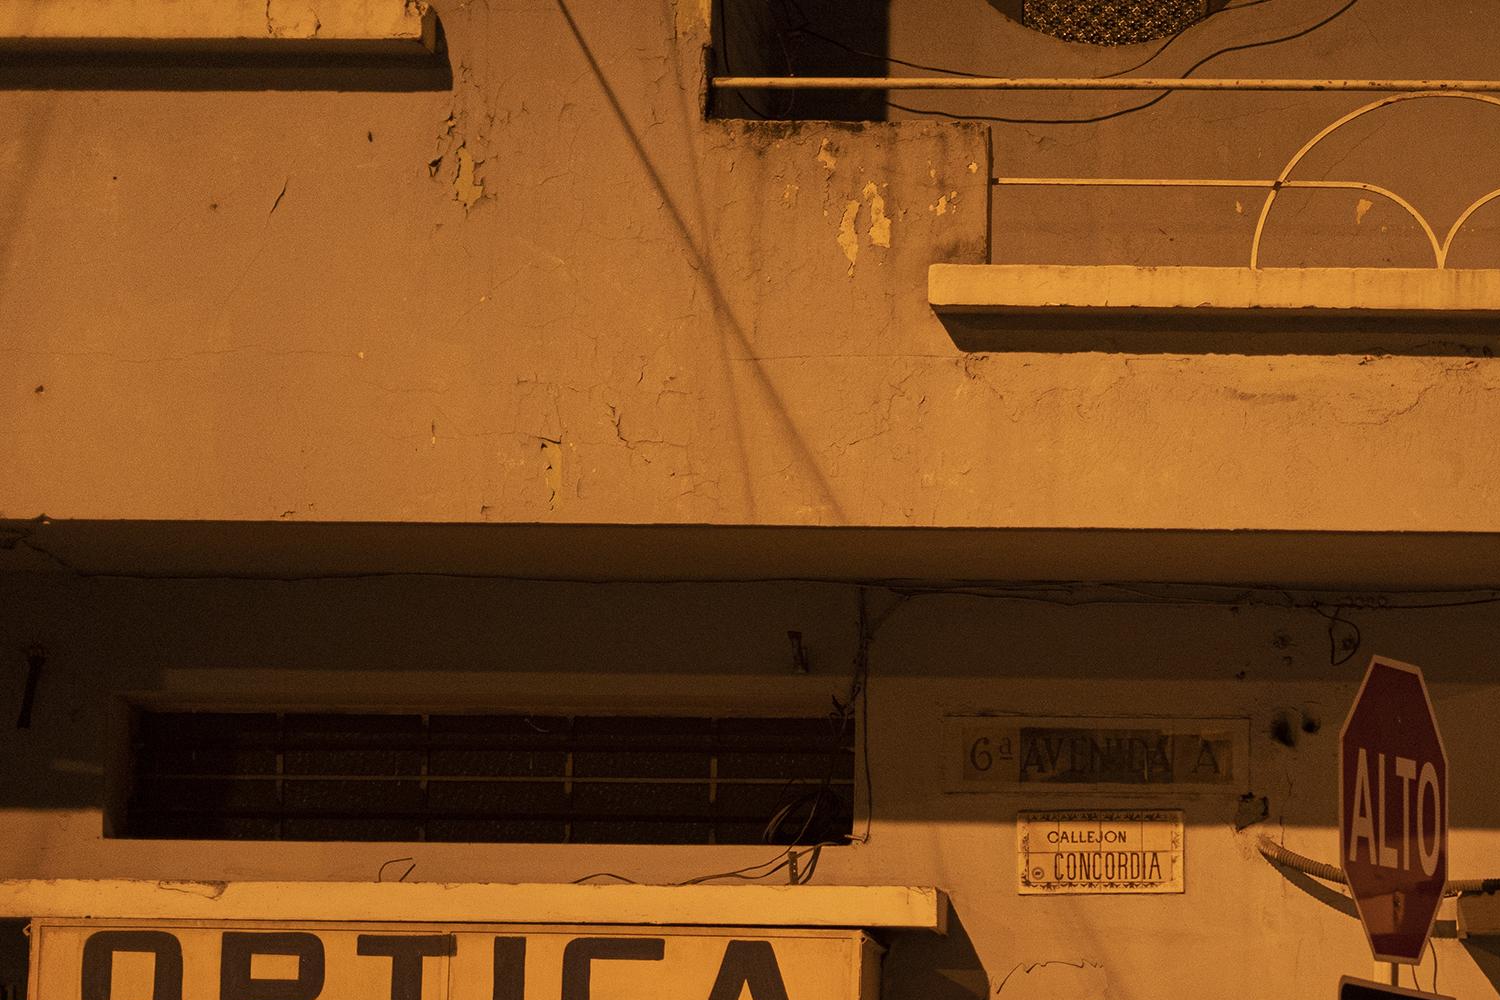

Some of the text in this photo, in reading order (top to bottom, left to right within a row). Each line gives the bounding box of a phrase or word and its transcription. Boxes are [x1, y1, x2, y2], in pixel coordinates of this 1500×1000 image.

[1191, 740, 1221, 774] A
[1349, 746, 1441, 877] ALTO
[1046, 830, 1127, 844] CALLEJON
[1053, 852, 1162, 880] CONCORDIA
